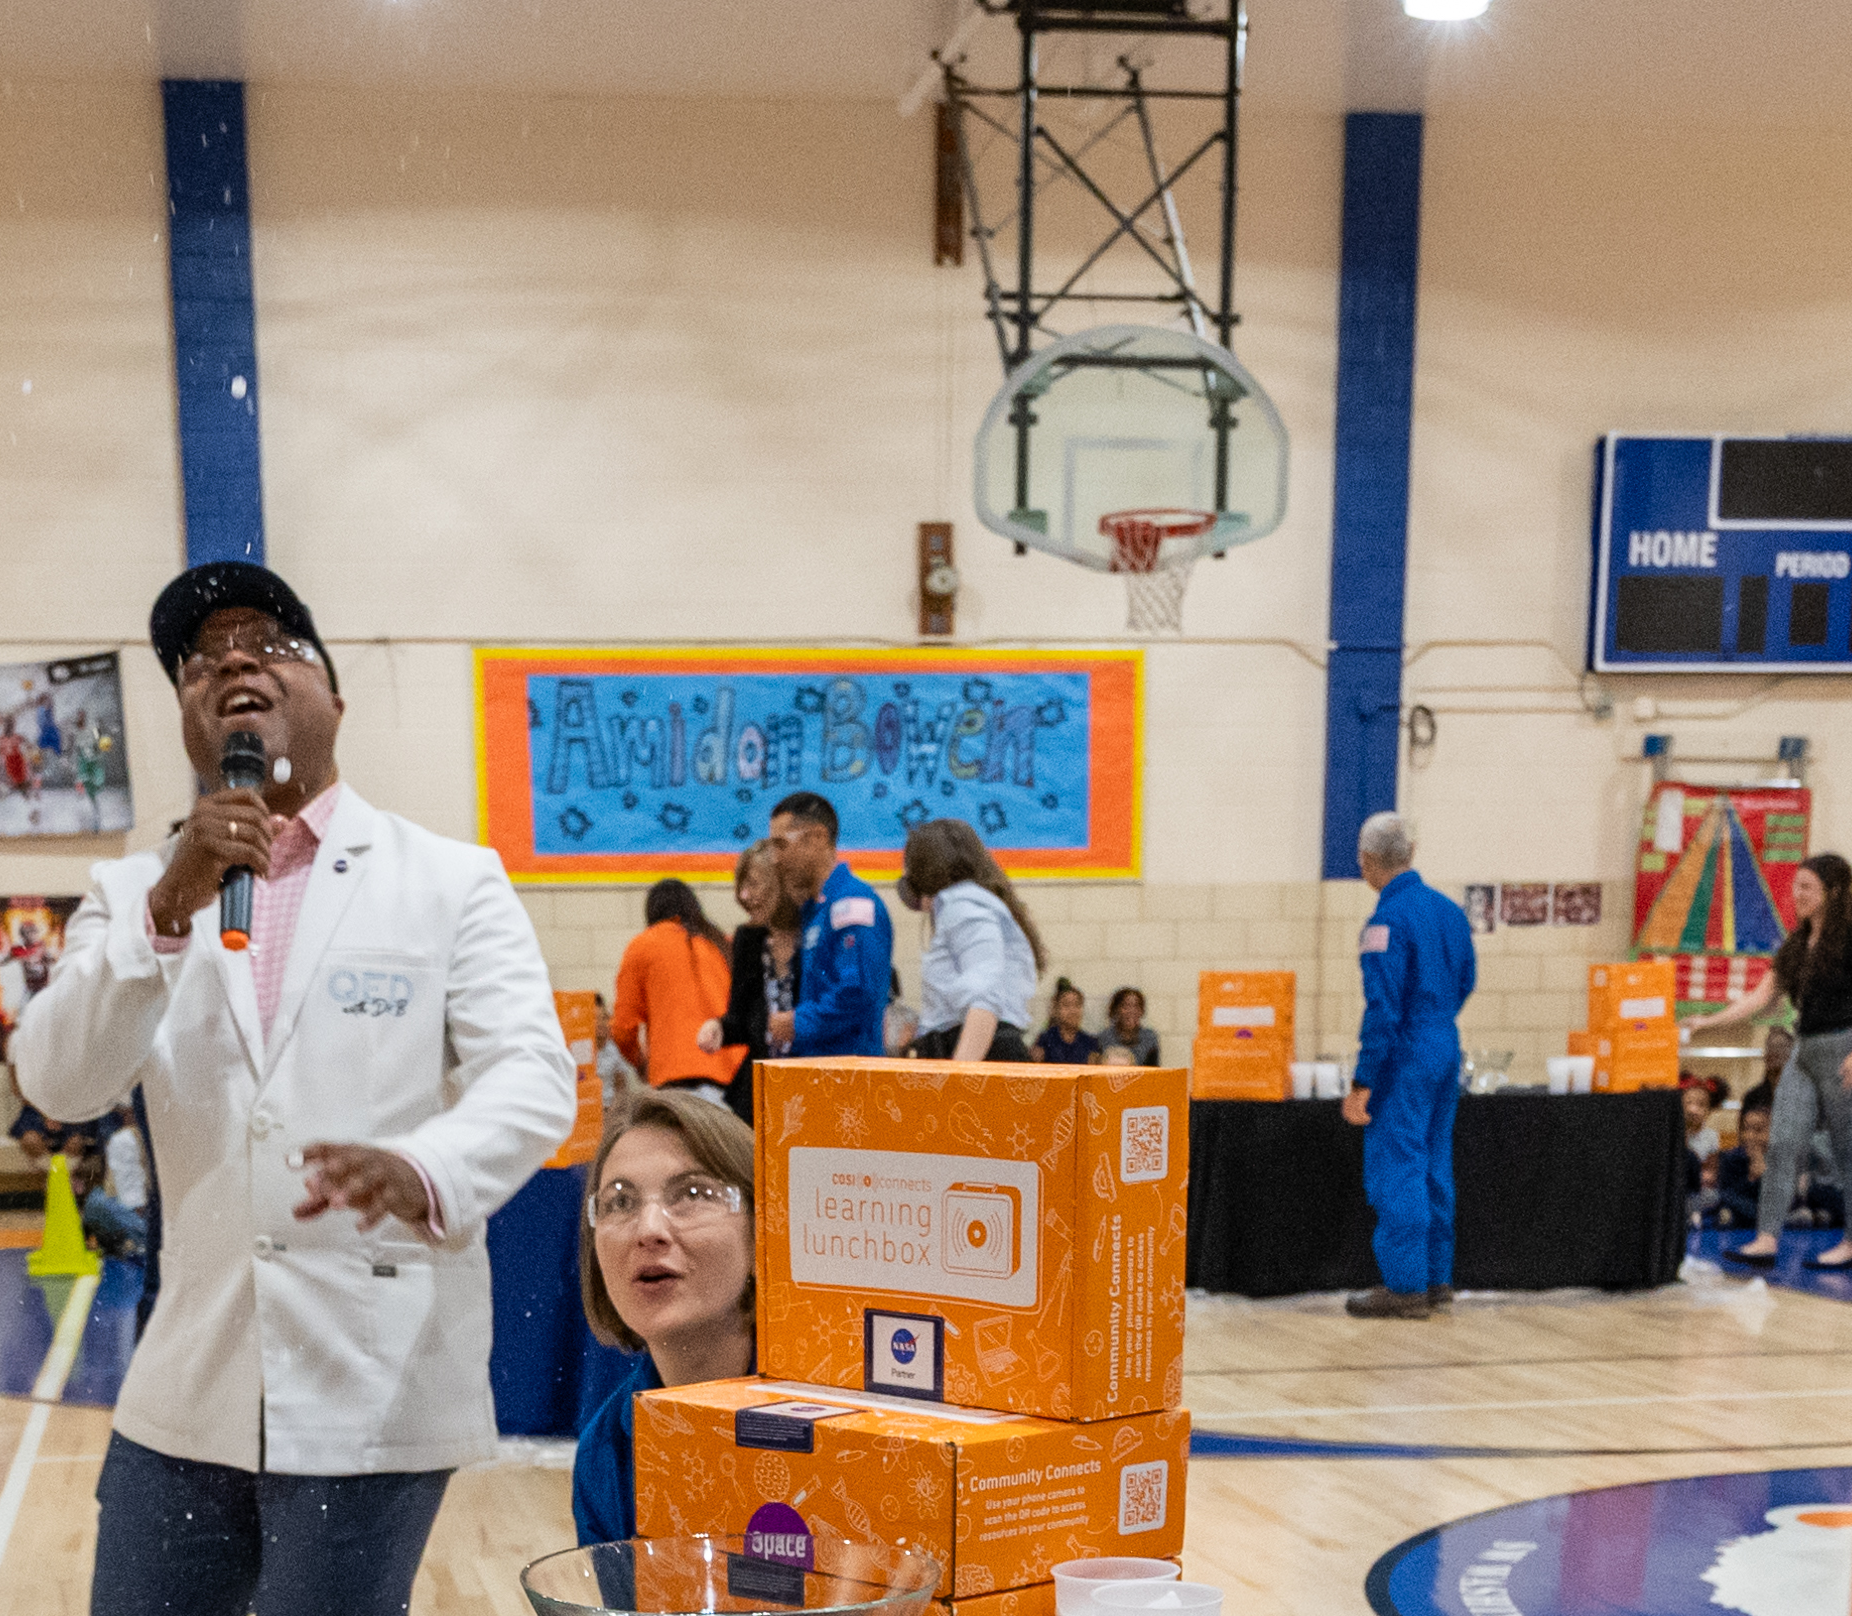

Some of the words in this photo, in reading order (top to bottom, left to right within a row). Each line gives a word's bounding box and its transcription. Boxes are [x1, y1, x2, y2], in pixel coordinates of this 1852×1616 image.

[1627, 531, 1719, 568] HOME
[1774, 551, 1850, 580] PERIOD
[549, 678, 804, 797] Amidon
[821, 676, 1037, 790] Bowen
[328, 969, 414, 1002] QED
[878, 1177, 933, 1193] connects
[815, 1187, 932, 1238] learning
[803, 1223, 931, 1267] lunchbox
[1109, 1214, 1122, 1298] Connects
[1127, 1236, 1135, 1248] to
[1137, 1232, 1145, 1270] access
[1127, 1249, 1135, 1292] camera
[1146, 1225, 1156, 1288] community
[1137, 1271, 1144, 1283] to
[1125, 1293, 1135, 1328] phone
[1135, 1285, 1144, 1312] code
[1146, 1290, 1155, 1314] your
[1135, 1314, 1143, 1331] QR
[1146, 1316, 1153, 1328] in
[892, 1341, 915, 1353] NASA
[1107, 1302, 1122, 1402] Community
[1126, 1330, 1135, 1355] your
[1135, 1332, 1143, 1351] the
[1125, 1356, 1133, 1378] Use
[1135, 1353, 1143, 1378] scan
[1145, 1330, 1153, 1382] resources
[970, 1467, 1043, 1492] Community
[1045, 1459, 1101, 1480] Connects
[985, 1499, 1001, 1510] Use
[1002, 1497, 1020, 1509] your
[1022, 1492, 1047, 1505] phone
[1048, 1487, 1076, 1500] camera
[1077, 1486, 1086, 1495] to
[984, 1514, 1003, 1526] scan
[1004, 1511, 1017, 1522] the
[1018, 1508, 1031, 1520] QR
[1032, 1506, 1050, 1518] code
[1051, 1504, 1059, 1514] to
[1060, 1501, 1086, 1513] access
[979, 1529, 1018, 1542] resources
[1019, 1526, 1027, 1535] in
[1028, 1523, 1046, 1535] your
[1047, 1515, 1090, 1530] community
[751, 1531, 807, 1560] Space
